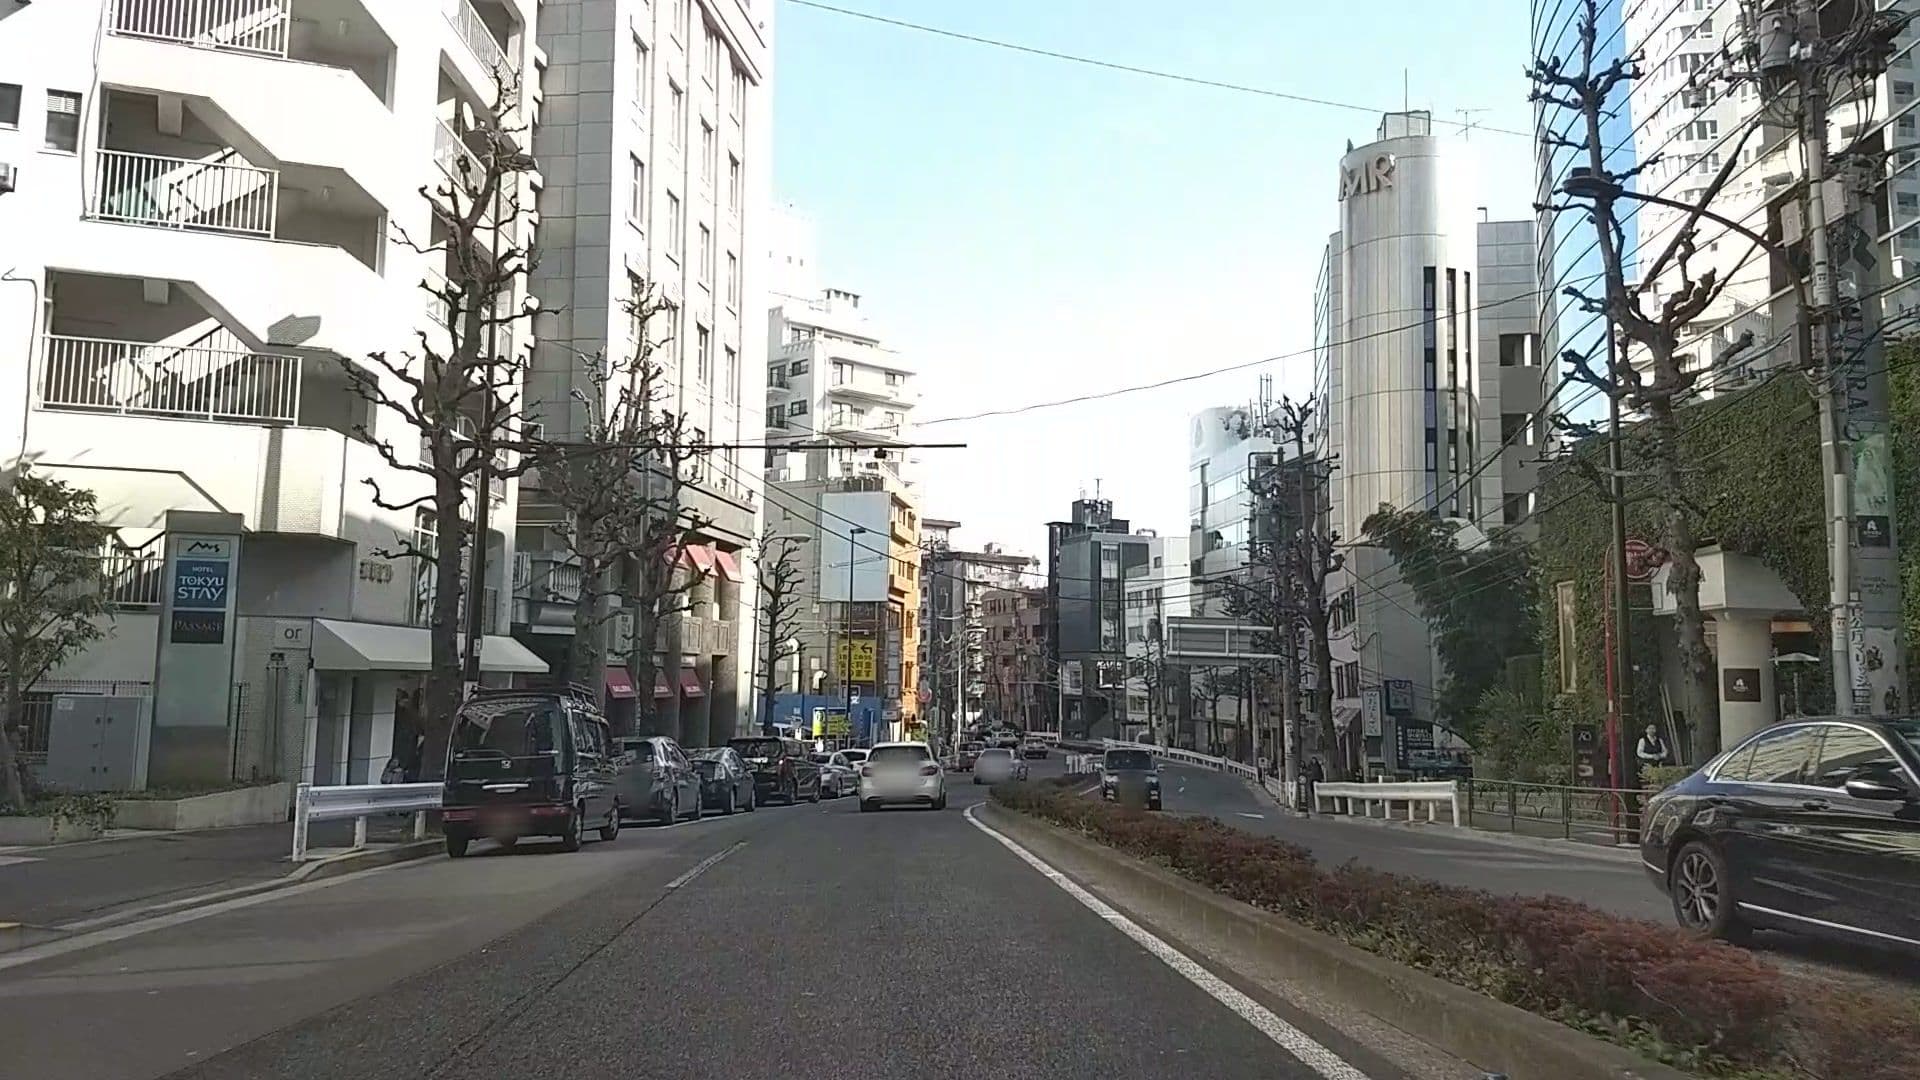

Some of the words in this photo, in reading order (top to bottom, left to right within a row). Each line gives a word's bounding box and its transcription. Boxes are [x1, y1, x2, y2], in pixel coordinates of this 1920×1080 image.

[191, 565, 214, 574] HOTEL
[179, 575, 225, 588] TOKYU
[177, 586, 225, 601] STAY
[173, 620, 224, 633] PASSAGE
[283, 627, 303, 640] or
